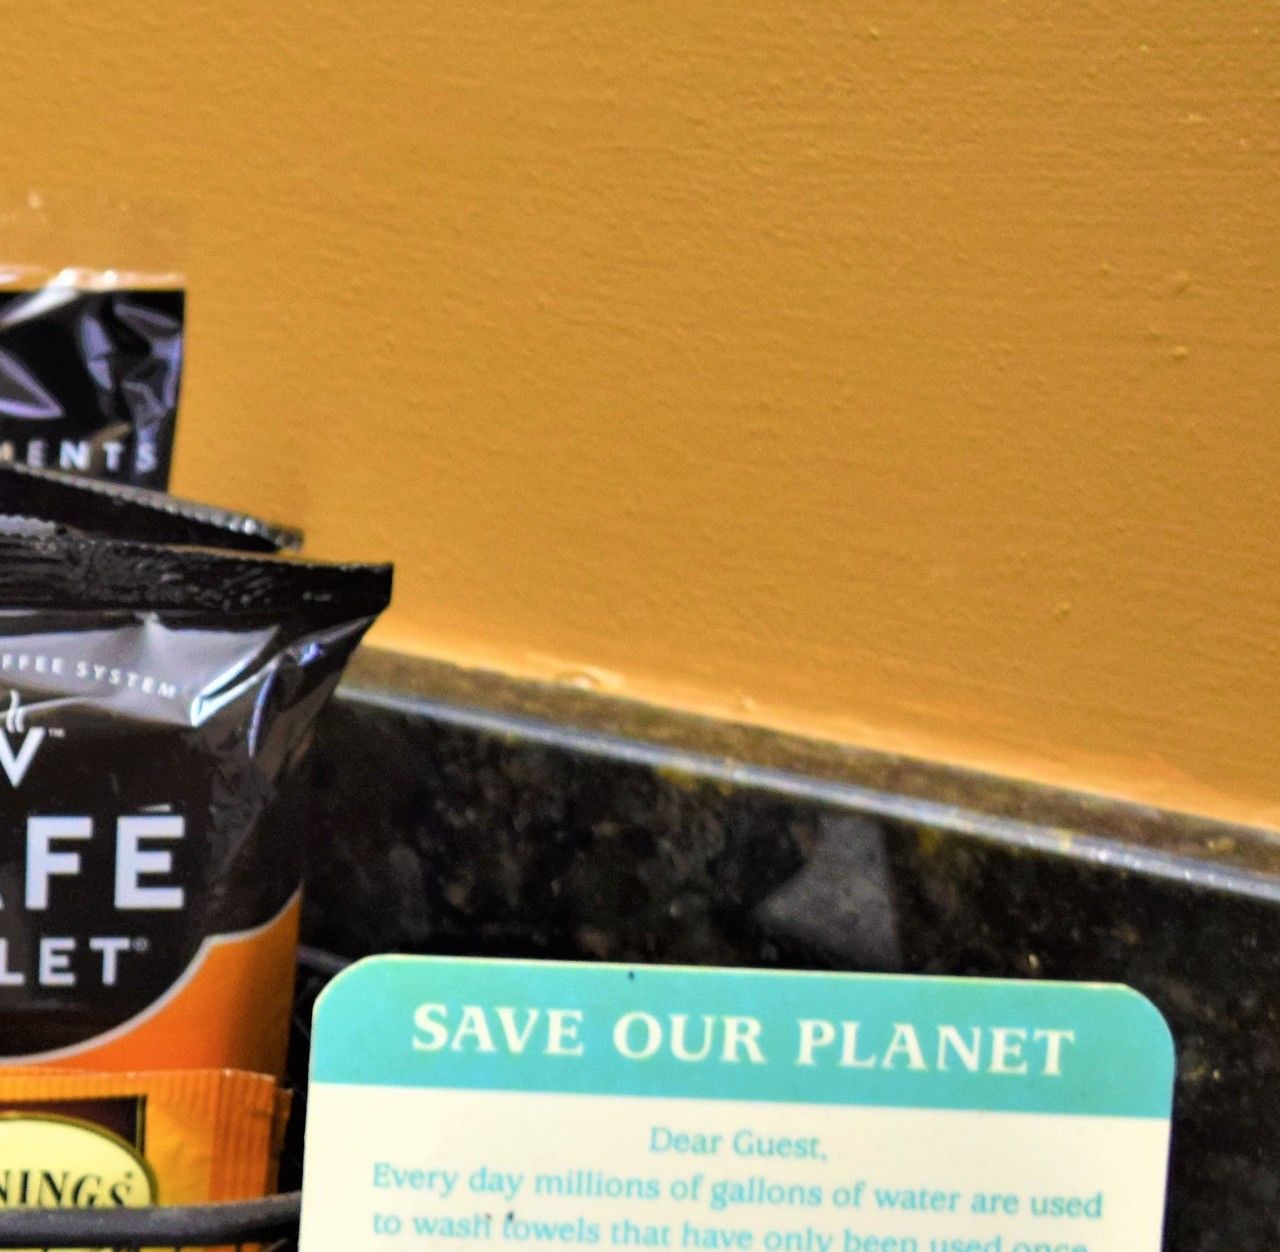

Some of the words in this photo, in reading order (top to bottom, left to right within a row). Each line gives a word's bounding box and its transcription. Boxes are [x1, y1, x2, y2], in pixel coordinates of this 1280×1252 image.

[75, 661, 177, 699] SYSTEM
[411, 1001, 584, 1056] SAVE
[611, 1010, 766, 1064] OUR
[795, 1018, 1075, 1076] PLANET
[647, 1124, 724, 1156] Dear
[730, 1128, 828, 1162] Guest,
[371, 1160, 459, 1199] Every
[467, 1165, 525, 1202] day
[533, 1168, 661, 1201] millions
[667, 1172, 705, 1201] of
[708, 1174, 824, 1212] gallons
[830, 1179, 867, 1209] of
[872, 1186, 962, 1213] water
[968, 1191, 1021, 1217] are
[1028, 1190, 1105, 1221] used
[371, 1211, 403, 1237] to
[411, 1212, 493, 1240] wash
[501, 1209, 601, 1245] towels
[609, 1217, 671, 1248] that
[679, 1220, 755, 1252] have
